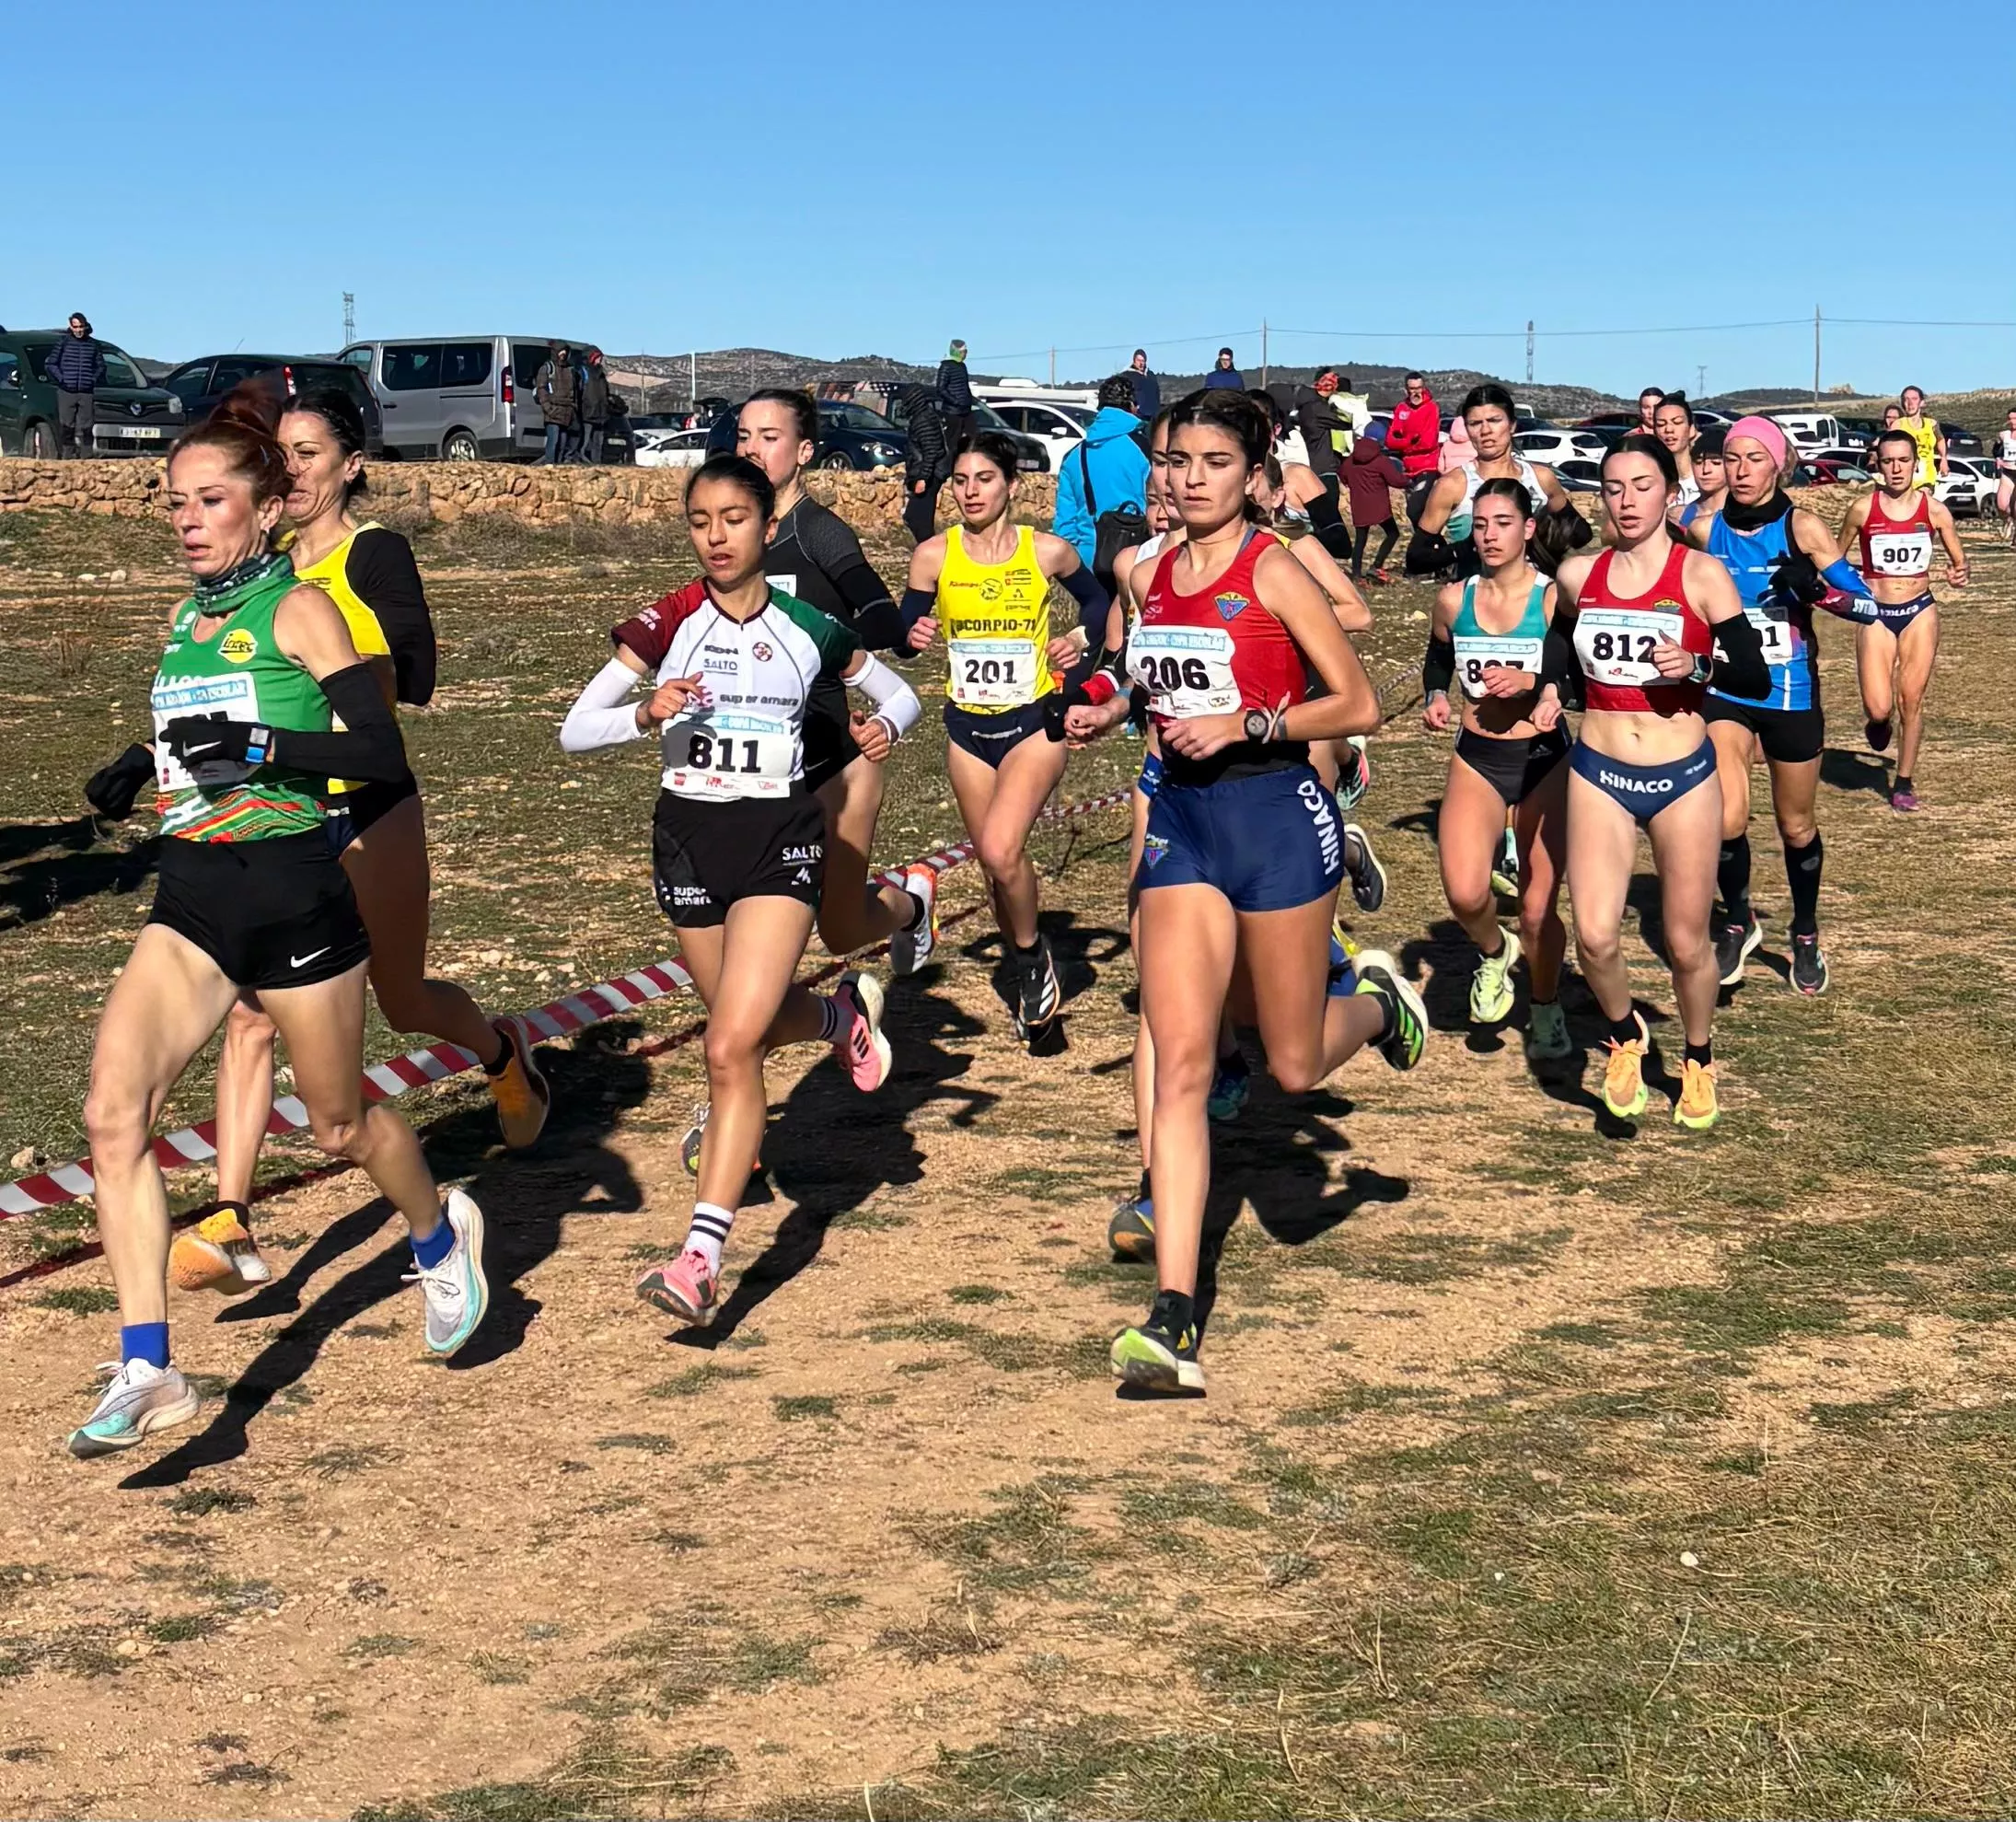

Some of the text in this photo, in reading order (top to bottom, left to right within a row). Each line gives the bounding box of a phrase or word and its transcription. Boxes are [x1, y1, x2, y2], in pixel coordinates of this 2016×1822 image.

[1883, 547, 1922, 563] 907
[1593, 632, 1658, 663] 812
[703, 657, 738, 671] SALTO
[965, 658, 1017, 684] 201
[1140, 655, 1211, 691] 206
[688, 734, 761, 773] 811
[1599, 770, 1674, 794] HINACO
[1296, 780, 1340, 876] HINACO
